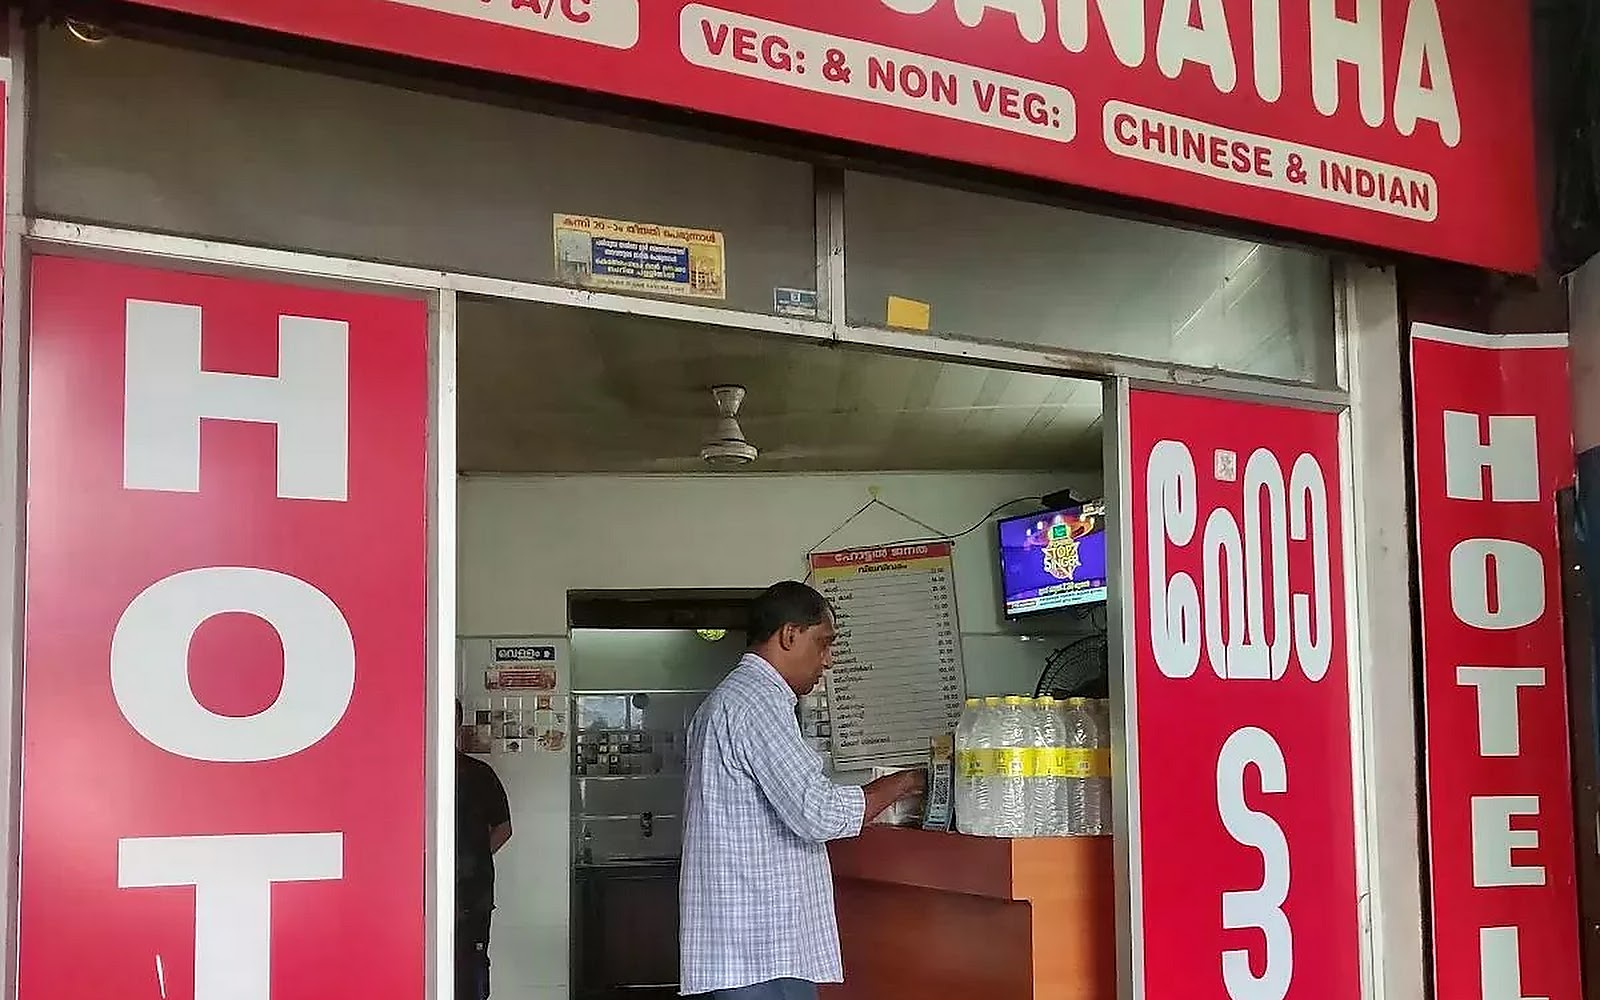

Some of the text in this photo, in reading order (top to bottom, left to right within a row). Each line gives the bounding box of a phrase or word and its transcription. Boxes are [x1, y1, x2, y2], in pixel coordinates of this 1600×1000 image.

[701, 19, 1061, 129] VEG: & NON VEG:
[1113, 113, 1430, 212] CHINESE & INDIAN
[891, 545, 929, 556] ജനത
[110, 299, 357, 1000] HOT
[1443, 410, 1550, 1000] HOTEL
